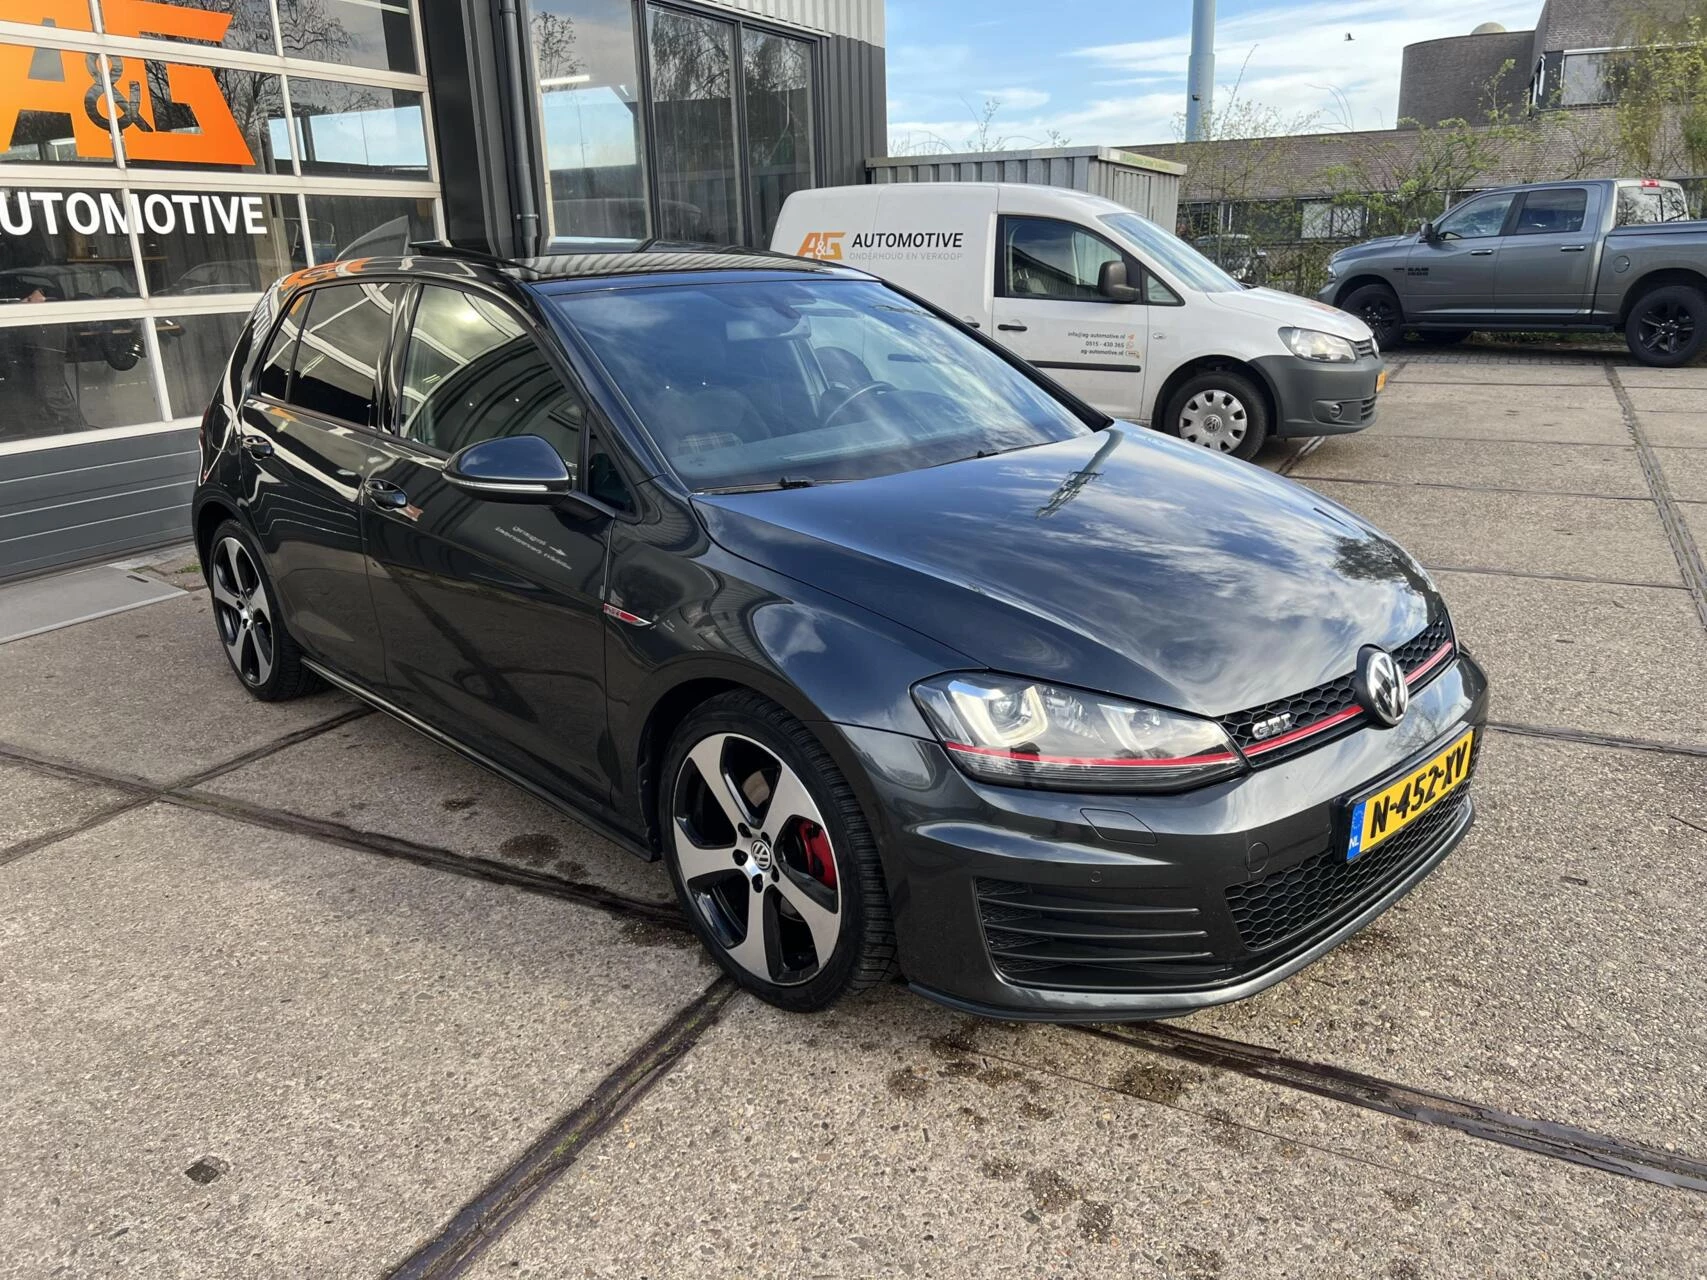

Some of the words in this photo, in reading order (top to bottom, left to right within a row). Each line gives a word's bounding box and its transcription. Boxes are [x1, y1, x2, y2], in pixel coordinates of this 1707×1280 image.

[0, 190, 268, 236] UTOMOTIVE
[796, 232, 846, 261] A&G
[852, 232, 964, 248] AUTOMOTIVE
[849, 252, 904, 261] ONDERHOUD
[905, 252, 918, 261] EN
[920, 252, 963, 261] VERKOOP
[1252, 712, 1293, 740] GTI
[1370, 741, 1468, 839] N-452-XV
[1350, 835, 1360, 848] NL
